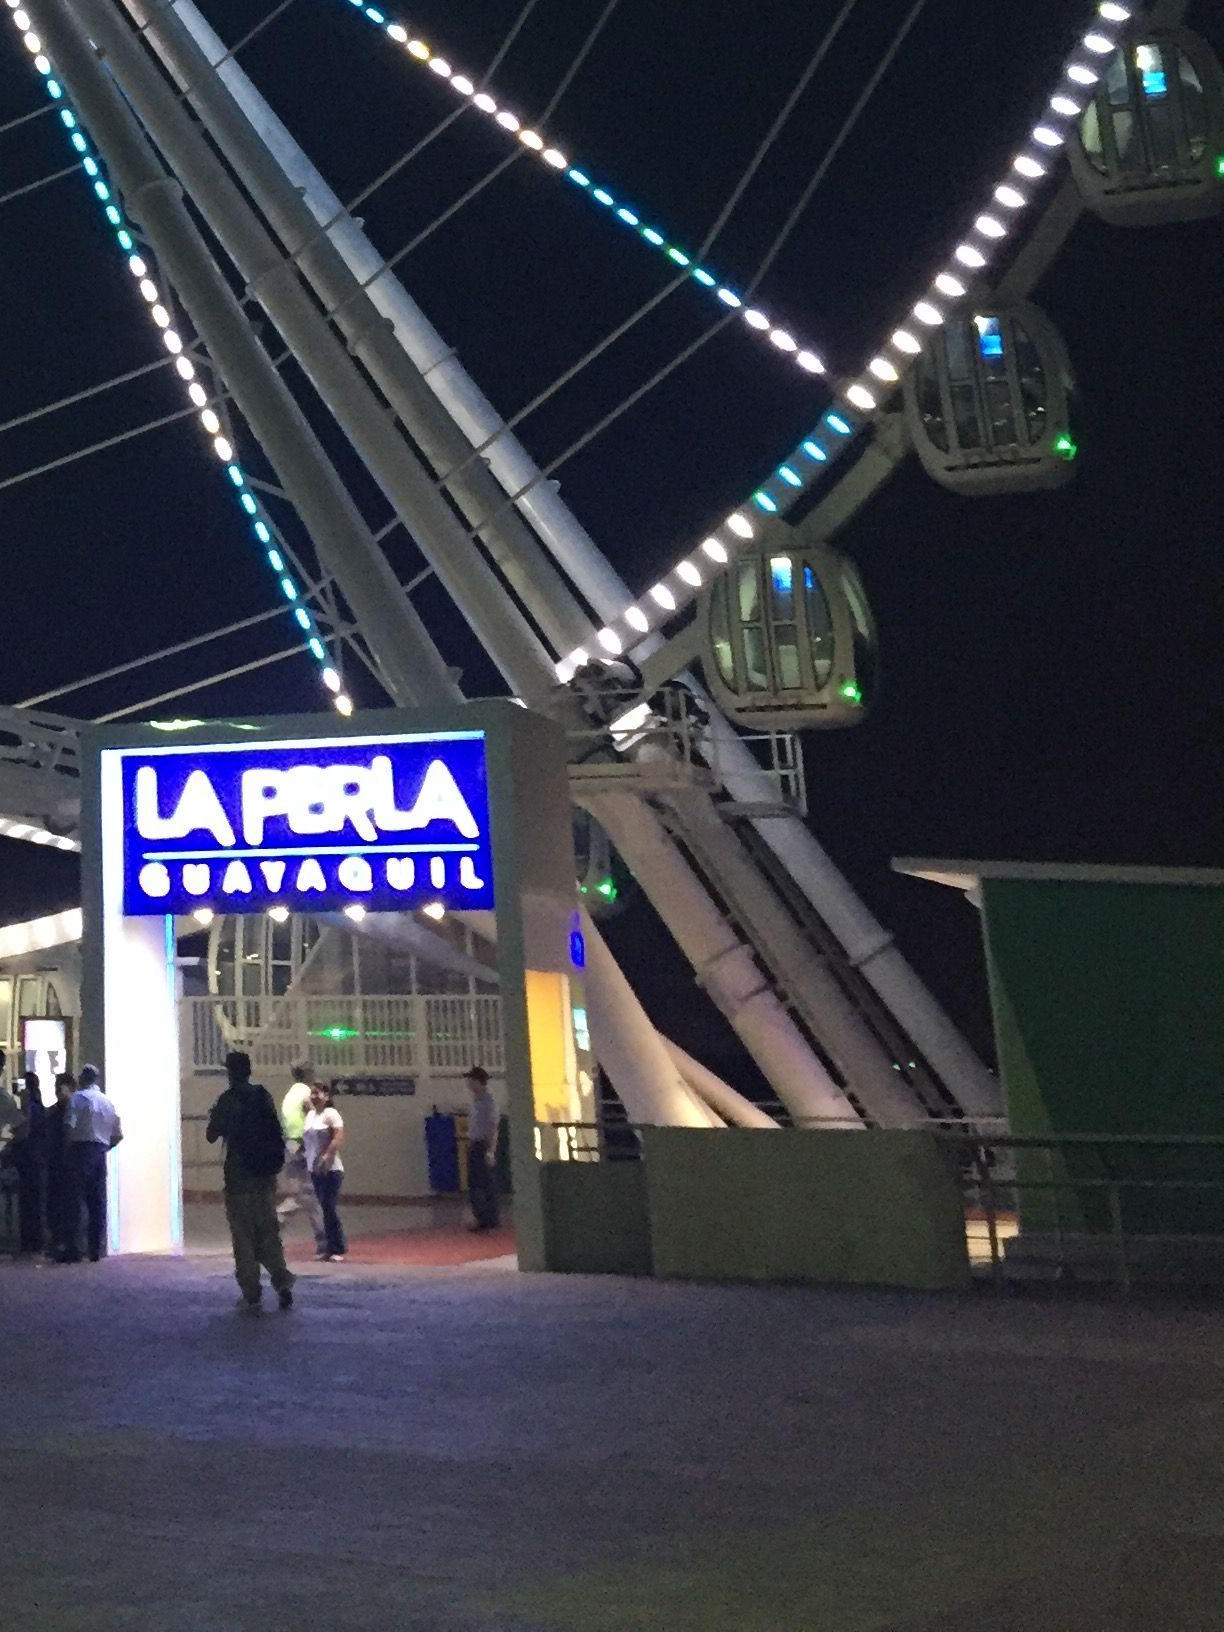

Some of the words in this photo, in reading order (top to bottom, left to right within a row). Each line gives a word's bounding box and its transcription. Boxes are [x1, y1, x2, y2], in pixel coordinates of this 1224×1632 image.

[135, 765, 236, 846] LA
[241, 755, 480, 846] PERLA
[138, 855, 484, 897] GUAYAQUIL
